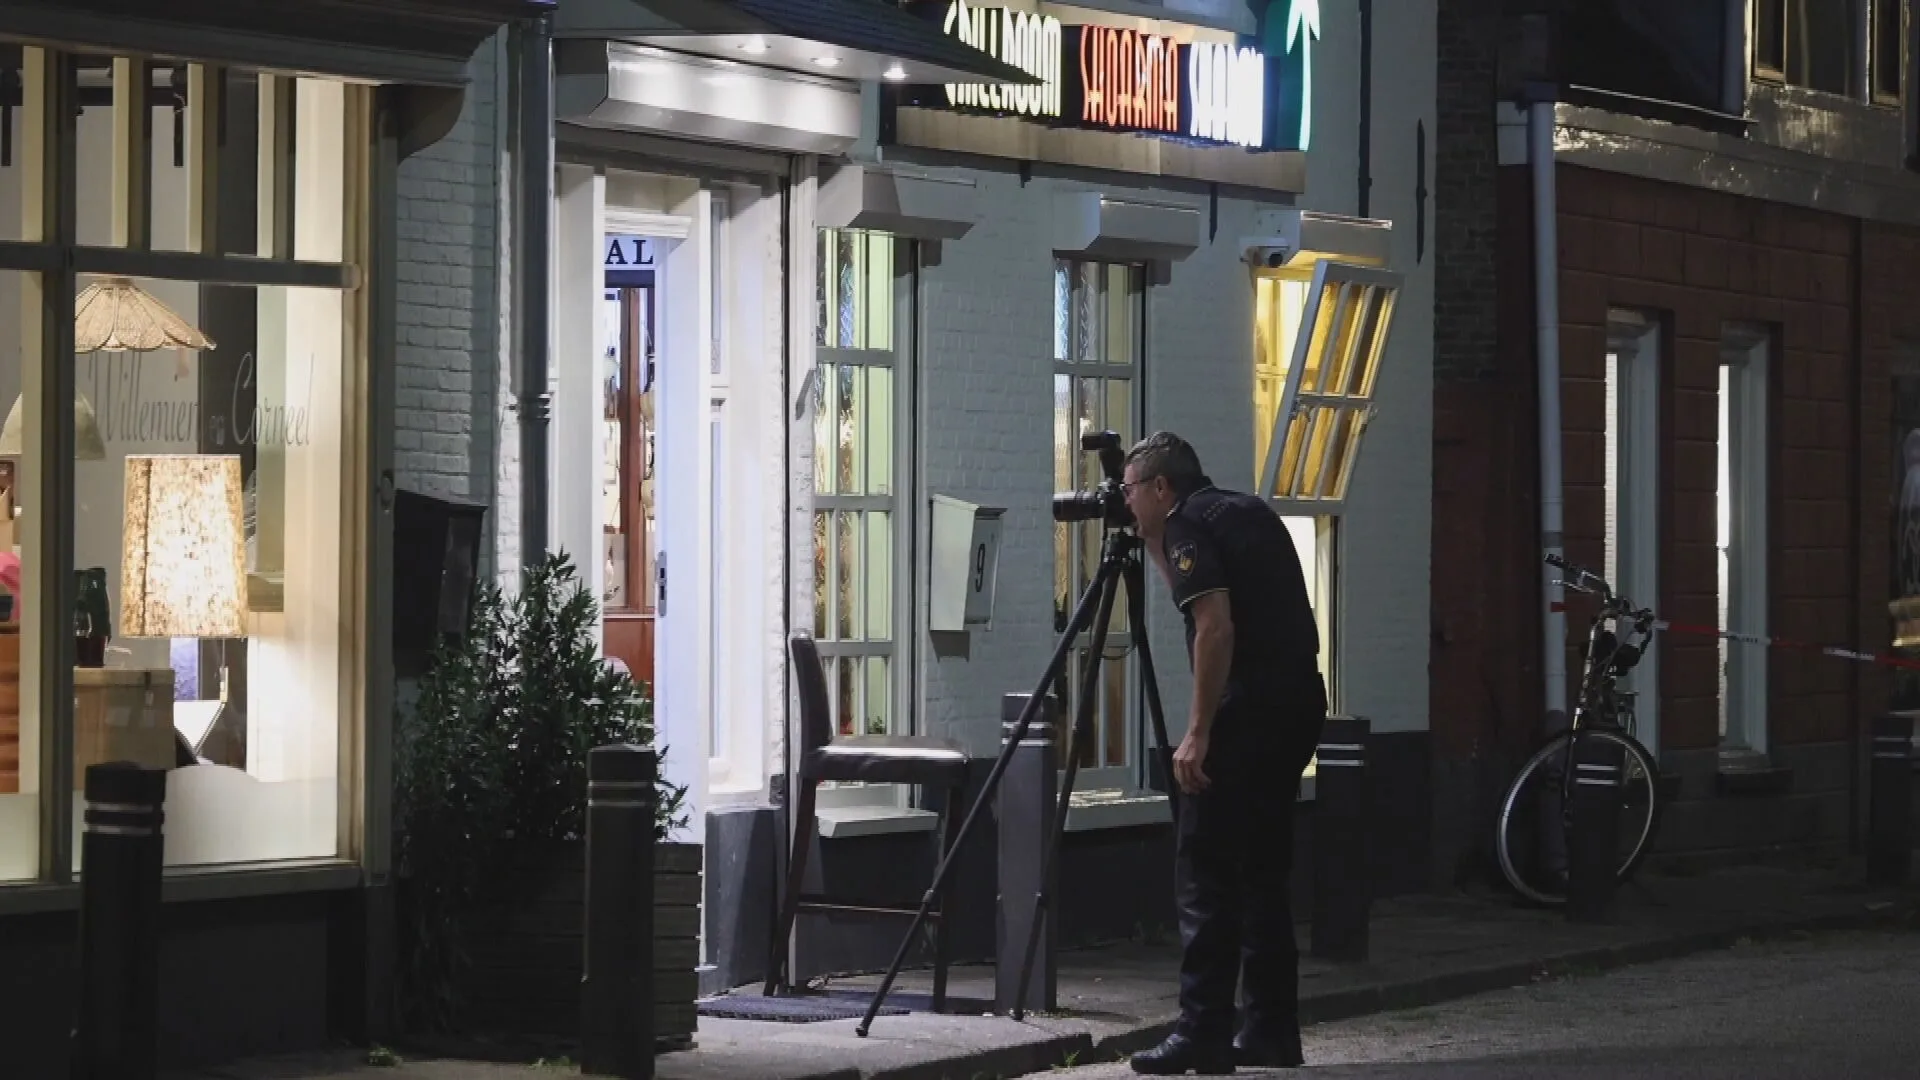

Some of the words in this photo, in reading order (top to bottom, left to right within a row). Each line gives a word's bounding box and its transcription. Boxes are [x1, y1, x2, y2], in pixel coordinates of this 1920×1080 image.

[1080, 24, 1178, 132] SHOARMA
[231, 350, 316, 447] Corneel
[975, 543, 986, 593] 9
